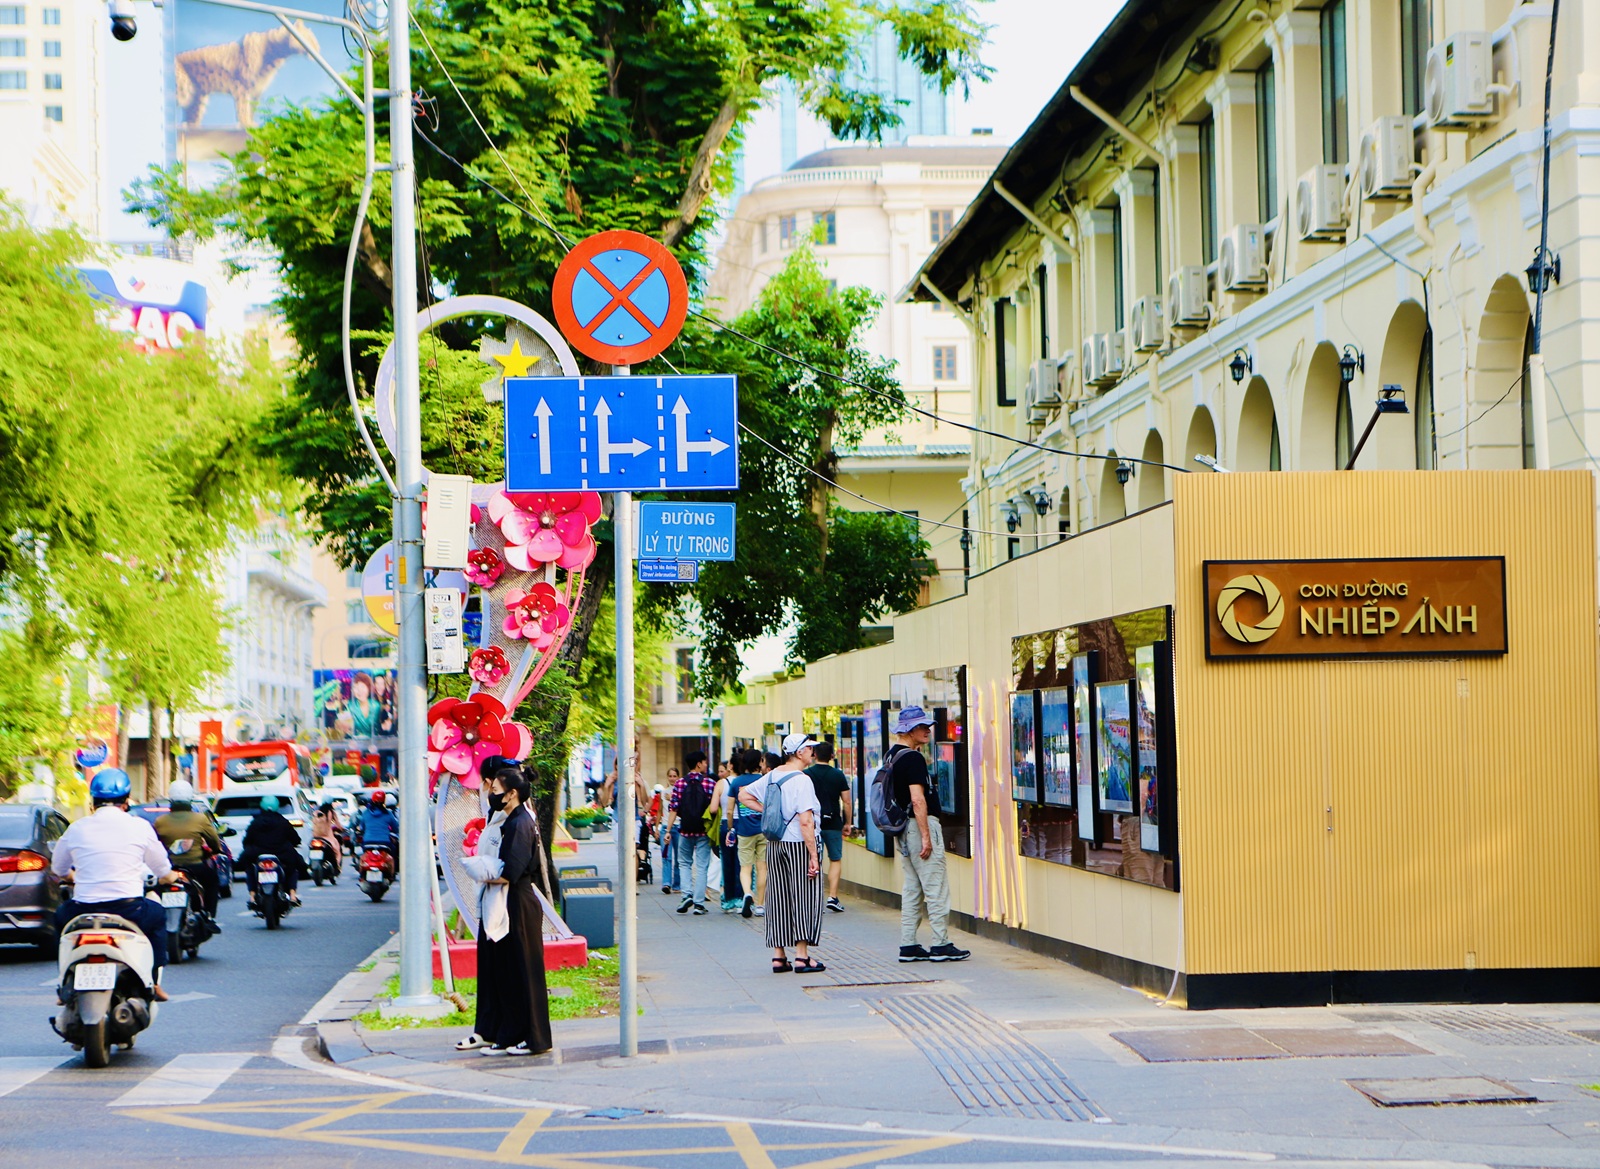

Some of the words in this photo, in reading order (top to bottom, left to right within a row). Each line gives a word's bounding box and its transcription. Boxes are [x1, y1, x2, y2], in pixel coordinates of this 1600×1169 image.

[661, 509, 715, 525] ĐƯỜNG
[645, 530, 659, 552] LÝ
[665, 534, 684, 556] TỰ
[688, 535, 729, 556] TRỌNG
[1299, 583, 1338, 597] CON
[1343, 578, 1408, 597] ĐƯỜNG
[1300, 598, 1400, 635] NHIẾP
[1401, 596, 1478, 633] ẢNH
